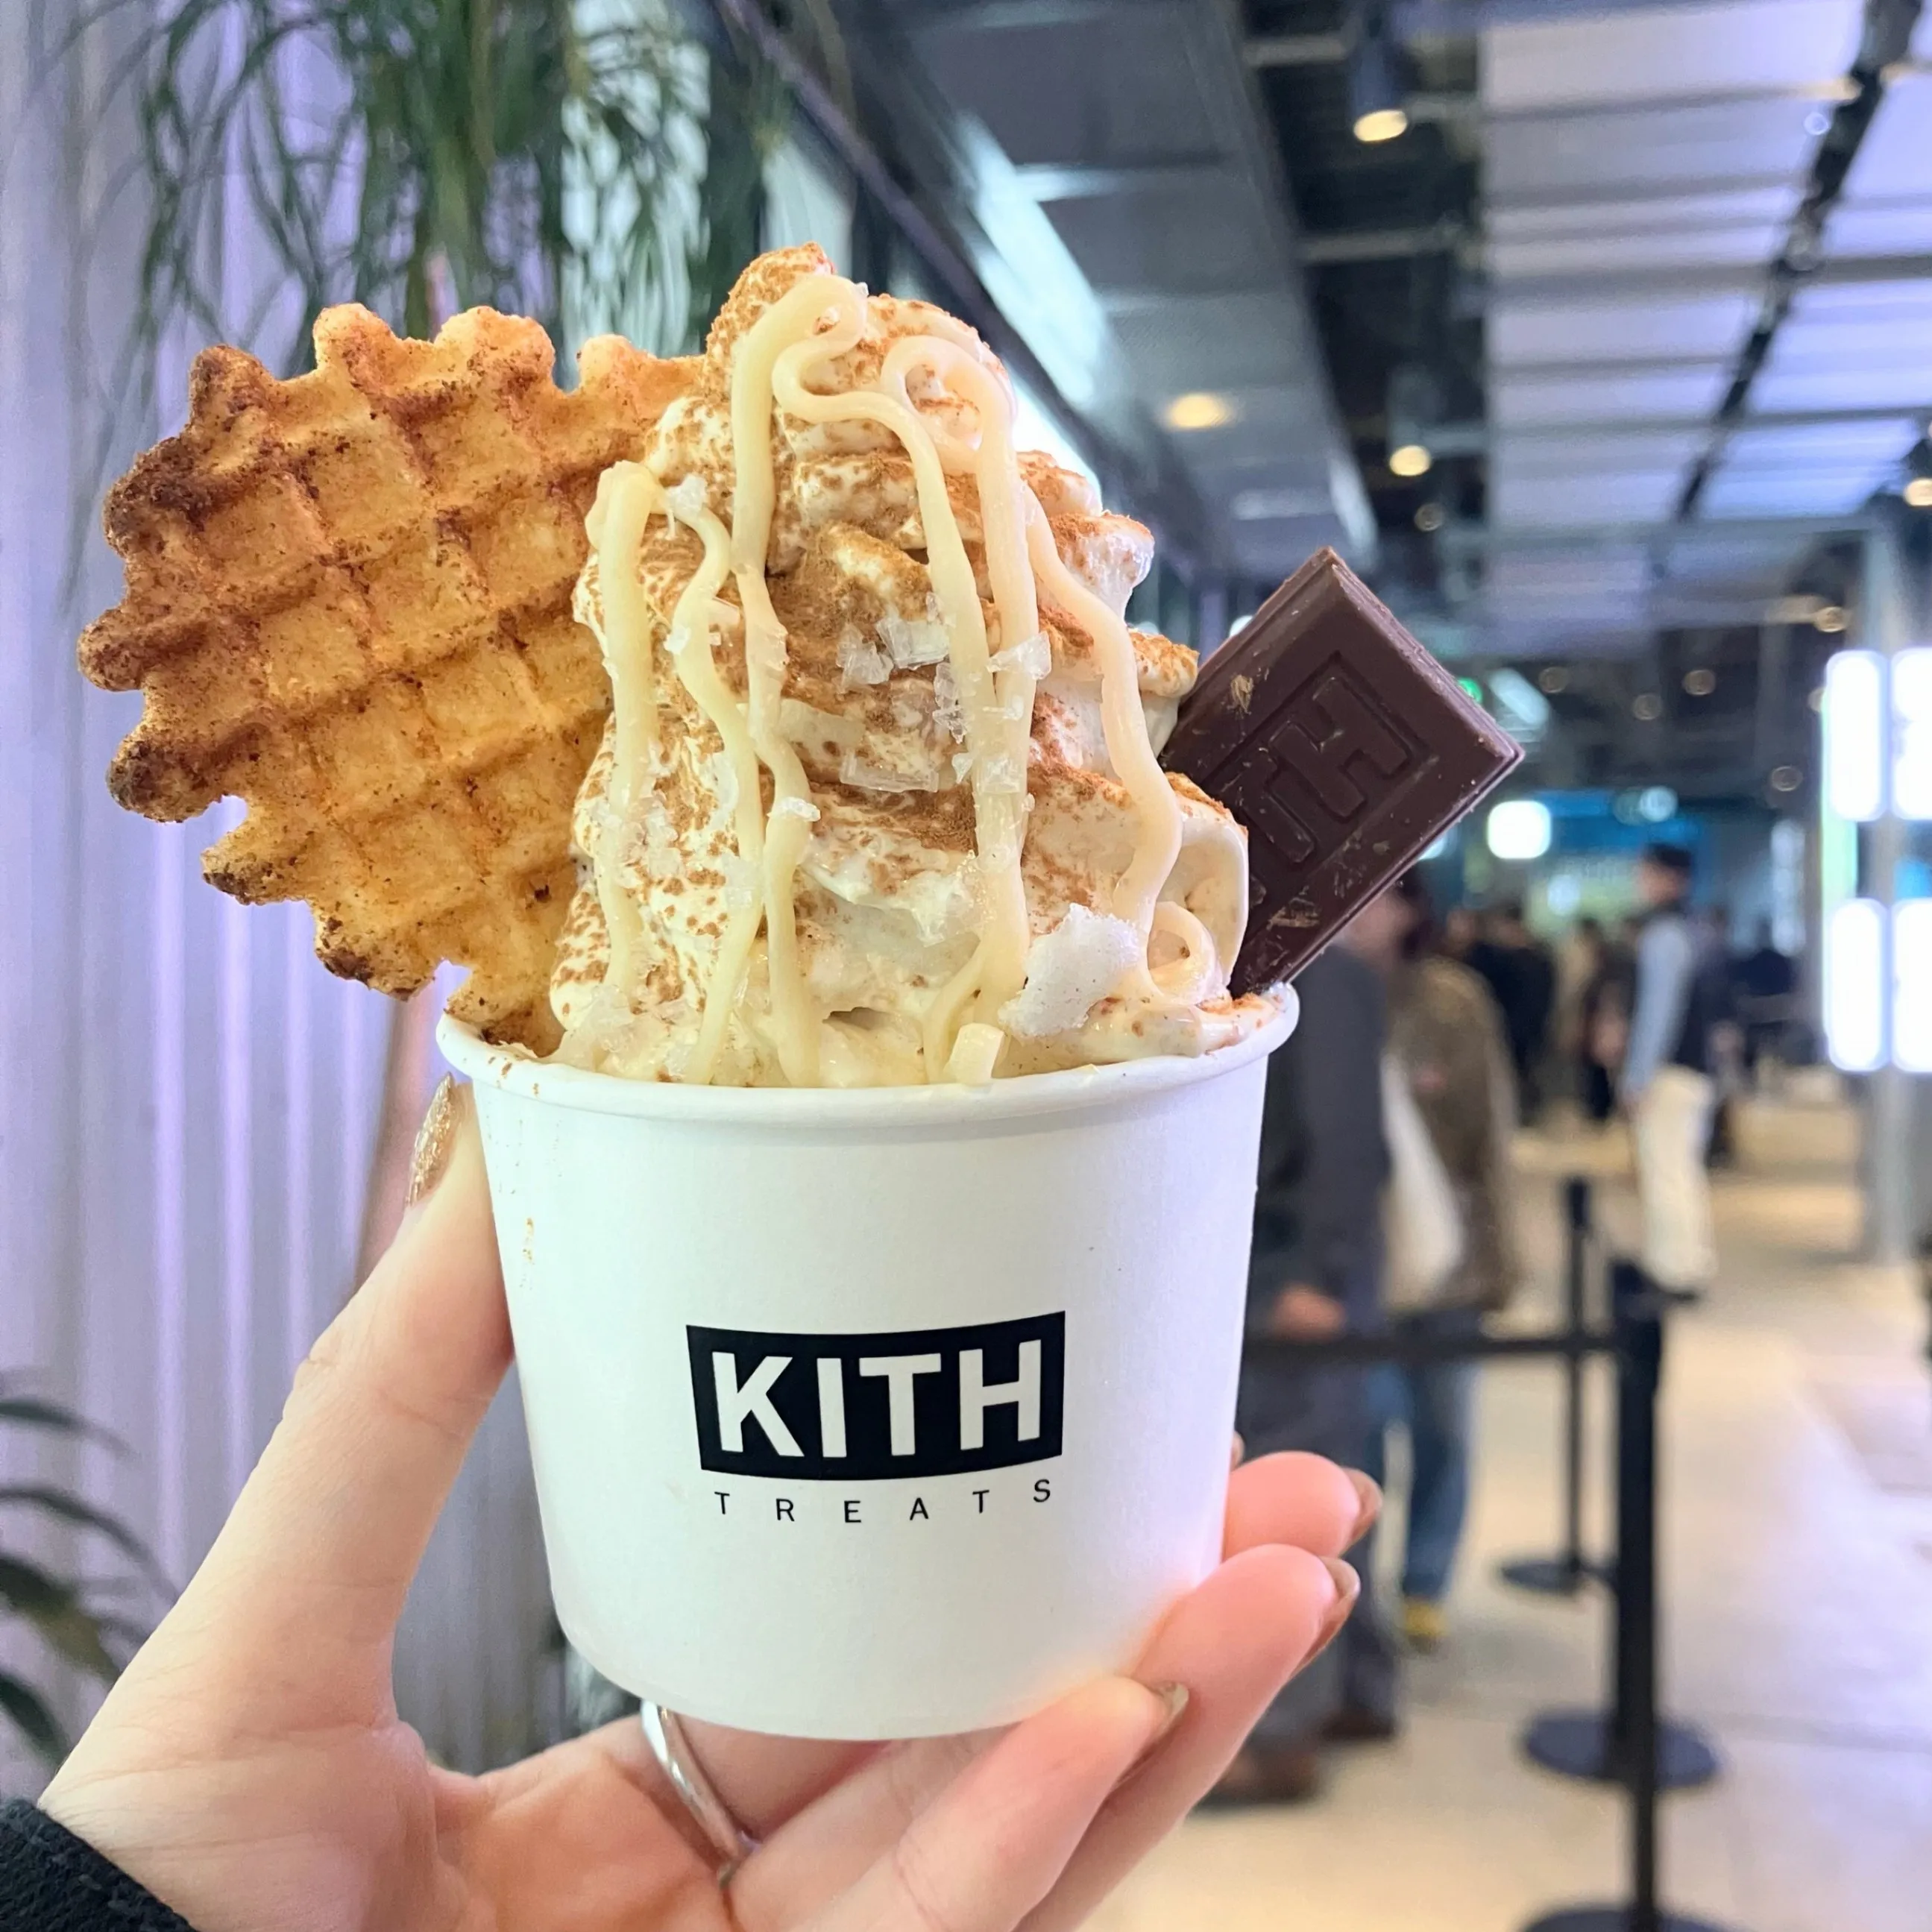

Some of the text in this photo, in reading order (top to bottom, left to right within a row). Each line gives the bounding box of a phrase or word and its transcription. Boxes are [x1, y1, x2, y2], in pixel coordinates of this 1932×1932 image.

[1218, 675, 1412, 904] TH
[711, 1339, 1041, 1458] KITH
[714, 1479, 1051, 1523] TREATS
